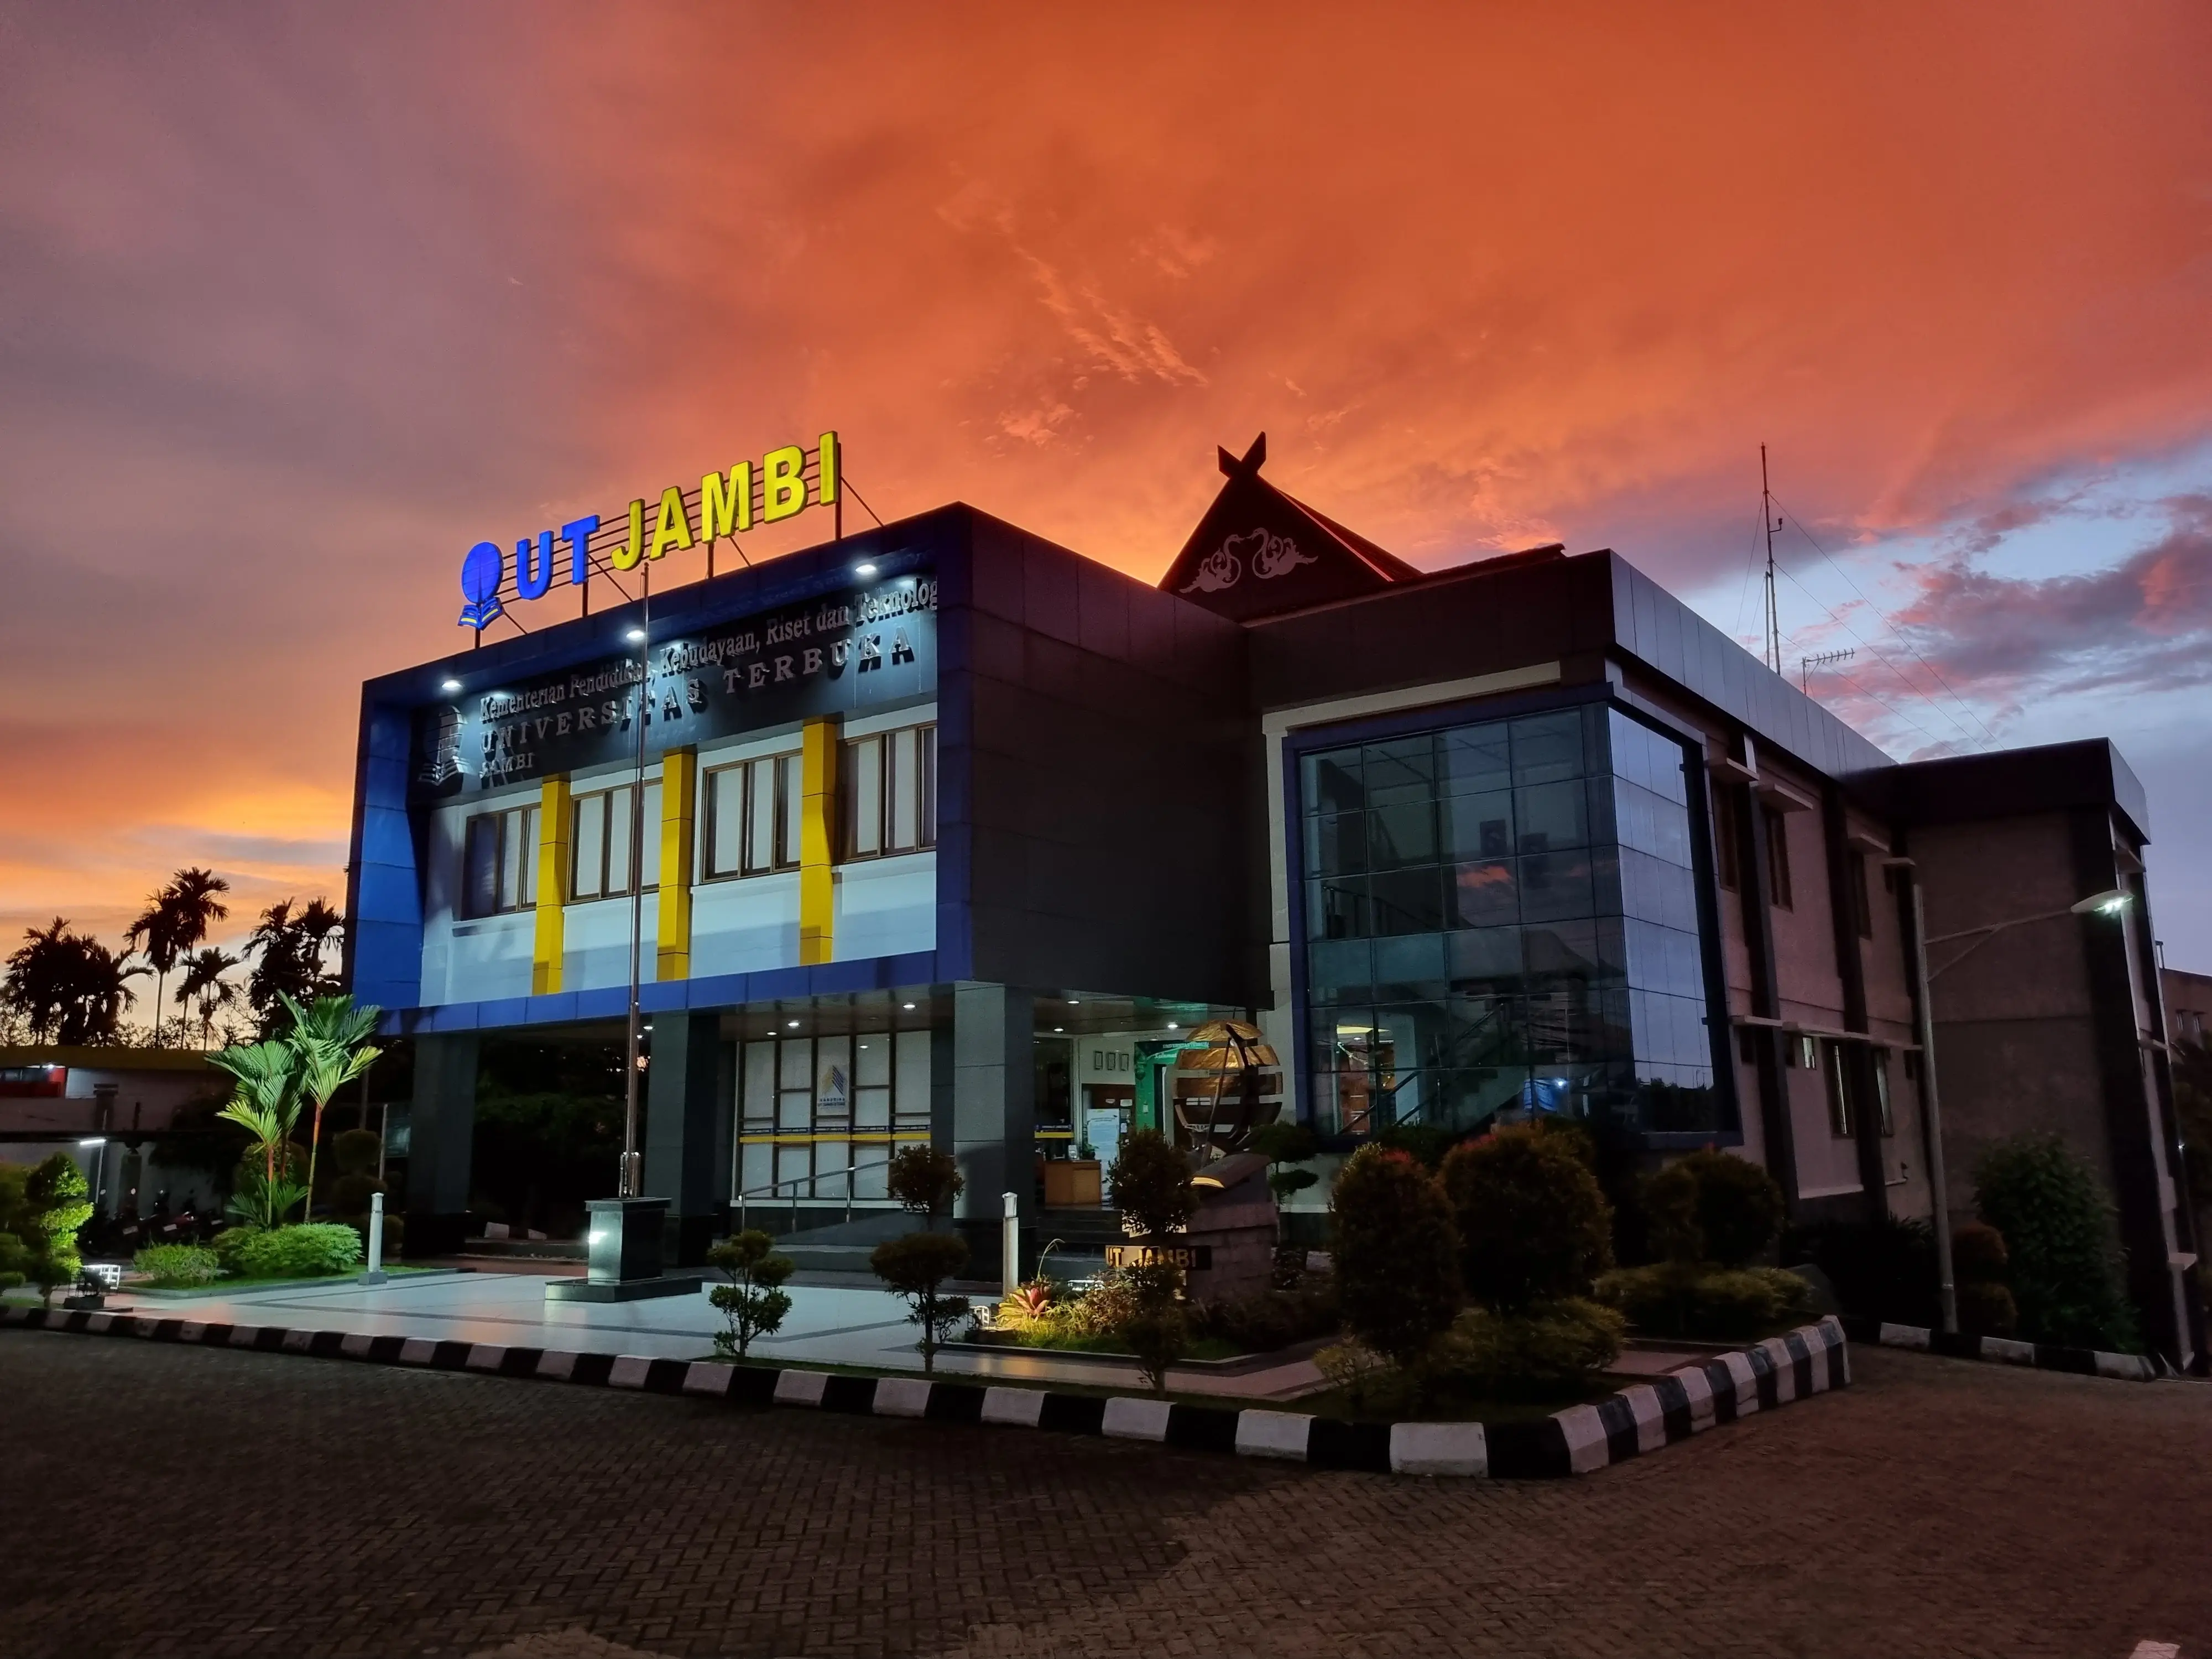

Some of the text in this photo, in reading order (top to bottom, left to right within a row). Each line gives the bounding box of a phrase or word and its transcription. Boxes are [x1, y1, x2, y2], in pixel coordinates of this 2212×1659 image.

[517, 431, 839, 599] UT JAMBI
[479, 684, 565, 722] Kementerian
[660, 632, 760, 674] Kebudayaan,
[766, 611, 811, 645] Riset
[816, 602, 850, 632] dan
[480, 626, 910, 753] UNIVERSITAS TERBUKA
[479, 752, 535, 778] JAMBI
